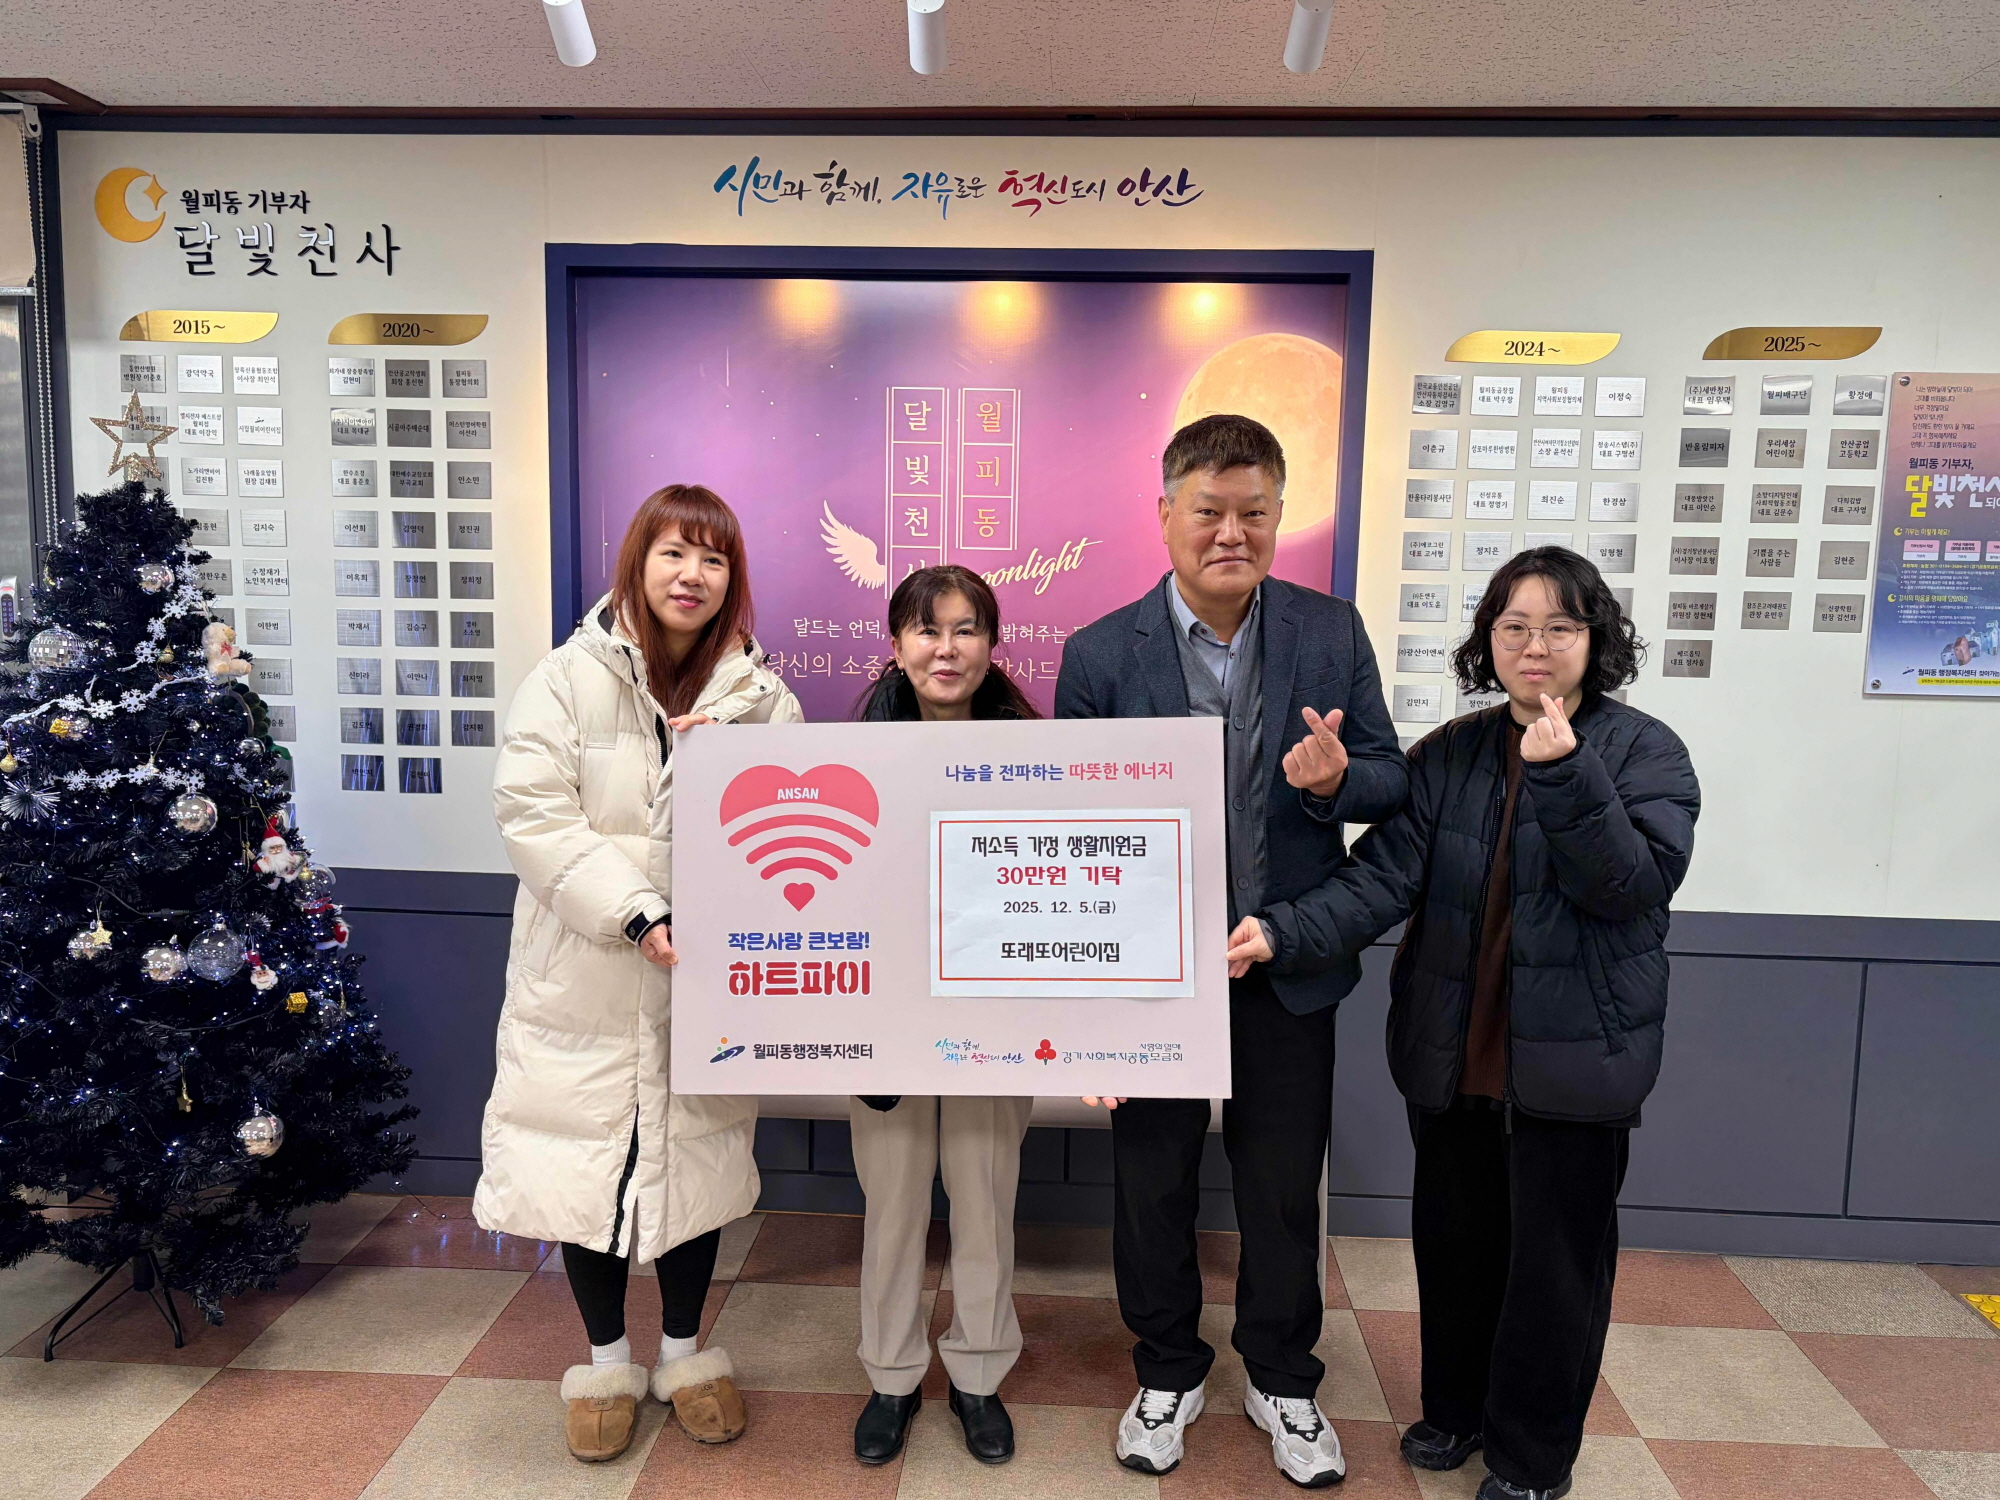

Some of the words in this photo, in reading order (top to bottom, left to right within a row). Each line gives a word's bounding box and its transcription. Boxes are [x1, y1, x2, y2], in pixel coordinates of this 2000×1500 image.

[713, 155, 812, 216] 시민과
[891, 171, 988, 220] 자유로운
[998, 169, 1106, 217] 혁신도시
[1117, 167, 1205, 207] 안산
[180, 189, 242, 215] 월피동
[248, 190, 310, 214] 기부자
[174, 221, 401, 277] 달빛천사
[173, 319, 226, 335] 2015~
[382, 322, 435, 338] 2020~
[1504, 340, 1561, 356] 2024~
[1764, 336, 1821, 352] 2025~
[186, 369, 214, 378] 광덕약국
[343, 377, 361, 385] 김현미
[1609, 392, 1632, 401] 이정숙
[1767, 390, 1807, 400] 월피배구단
[1689, 396, 1704, 404] 대표
[1685, 442, 1725, 452] 반올림피자
[1767, 439, 1796, 448] 우리세상
[1841, 440, 1869, 449] 안산공업
[1766, 449, 1795, 458] 어린이집
[1839, 450, 1868, 458] 고등학교
[1909, 458, 1939, 469] 월피동
[1942, 458, 1974, 470] 기부자,
[974, 402, 1001, 537] 월피동
[1541, 496, 1565, 504] 최진순
[1603, 498, 1626, 506] 한경삼
[1682, 503, 1694, 511] 대표
[1831, 506, 1844, 514] 대표
[253, 523, 274, 531] 김지숙
[344, 524, 366, 532] 이선희
[1476, 547, 1499, 556] 정지은
[1753, 549, 1774, 557] 기쁨을
[1777, 549, 1790, 557] 주는
[1674, 556, 1693, 565] 이사장
[1760, 558, 1781, 567] 사람들
[1833, 556, 1855, 565] 김현준
[980, 537, 1103, 595] oonlight
[252, 568, 280, 576] 수정재가
[245, 577, 288, 586] 노인복지센터
[1749, 611, 1762, 619] 관장
[1821, 613, 1834, 621] 원장
[257, 622, 279, 630] 이한범
[794, 618, 842, 637] 달드는
[849, 619, 885, 640] 언덕,
[1002, 623, 1067, 643] 밝혀주는
[1671, 658, 1683, 666] 대표
[840, 655, 895, 681] 소중
[1406, 698, 1429, 707] 김민지
[946, 764, 994, 782] 나눔을
[999, 764, 1064, 782] 전파하는
[1069, 762, 1119, 781] 따뜻한
[1124, 761, 1173, 780] 에너지
[777, 788, 819, 800] ANSAN
[971, 836, 1018, 857] 저소득
[1027, 836, 1058, 857] 가정
[1067, 835, 1146, 858] 생활지원금
[996, 866, 1066, 885] 30만원
[1080, 865, 1122, 885] 기탁
[1004, 901, 1042, 913] 2025.
[1051, 901, 1072, 913] 12.
[1080, 901, 1116, 914] 5.(금)
[728, 931, 803, 951] 작은사랑
[808, 931, 870, 950] 큰보람!
[1001, 942, 1120, 962] 또래또어린이집
[729, 960, 870, 996] 하트파이
[753, 1043, 873, 1059] 월피동행정복지센터
[1001, 1052, 1025, 1064] 안산
